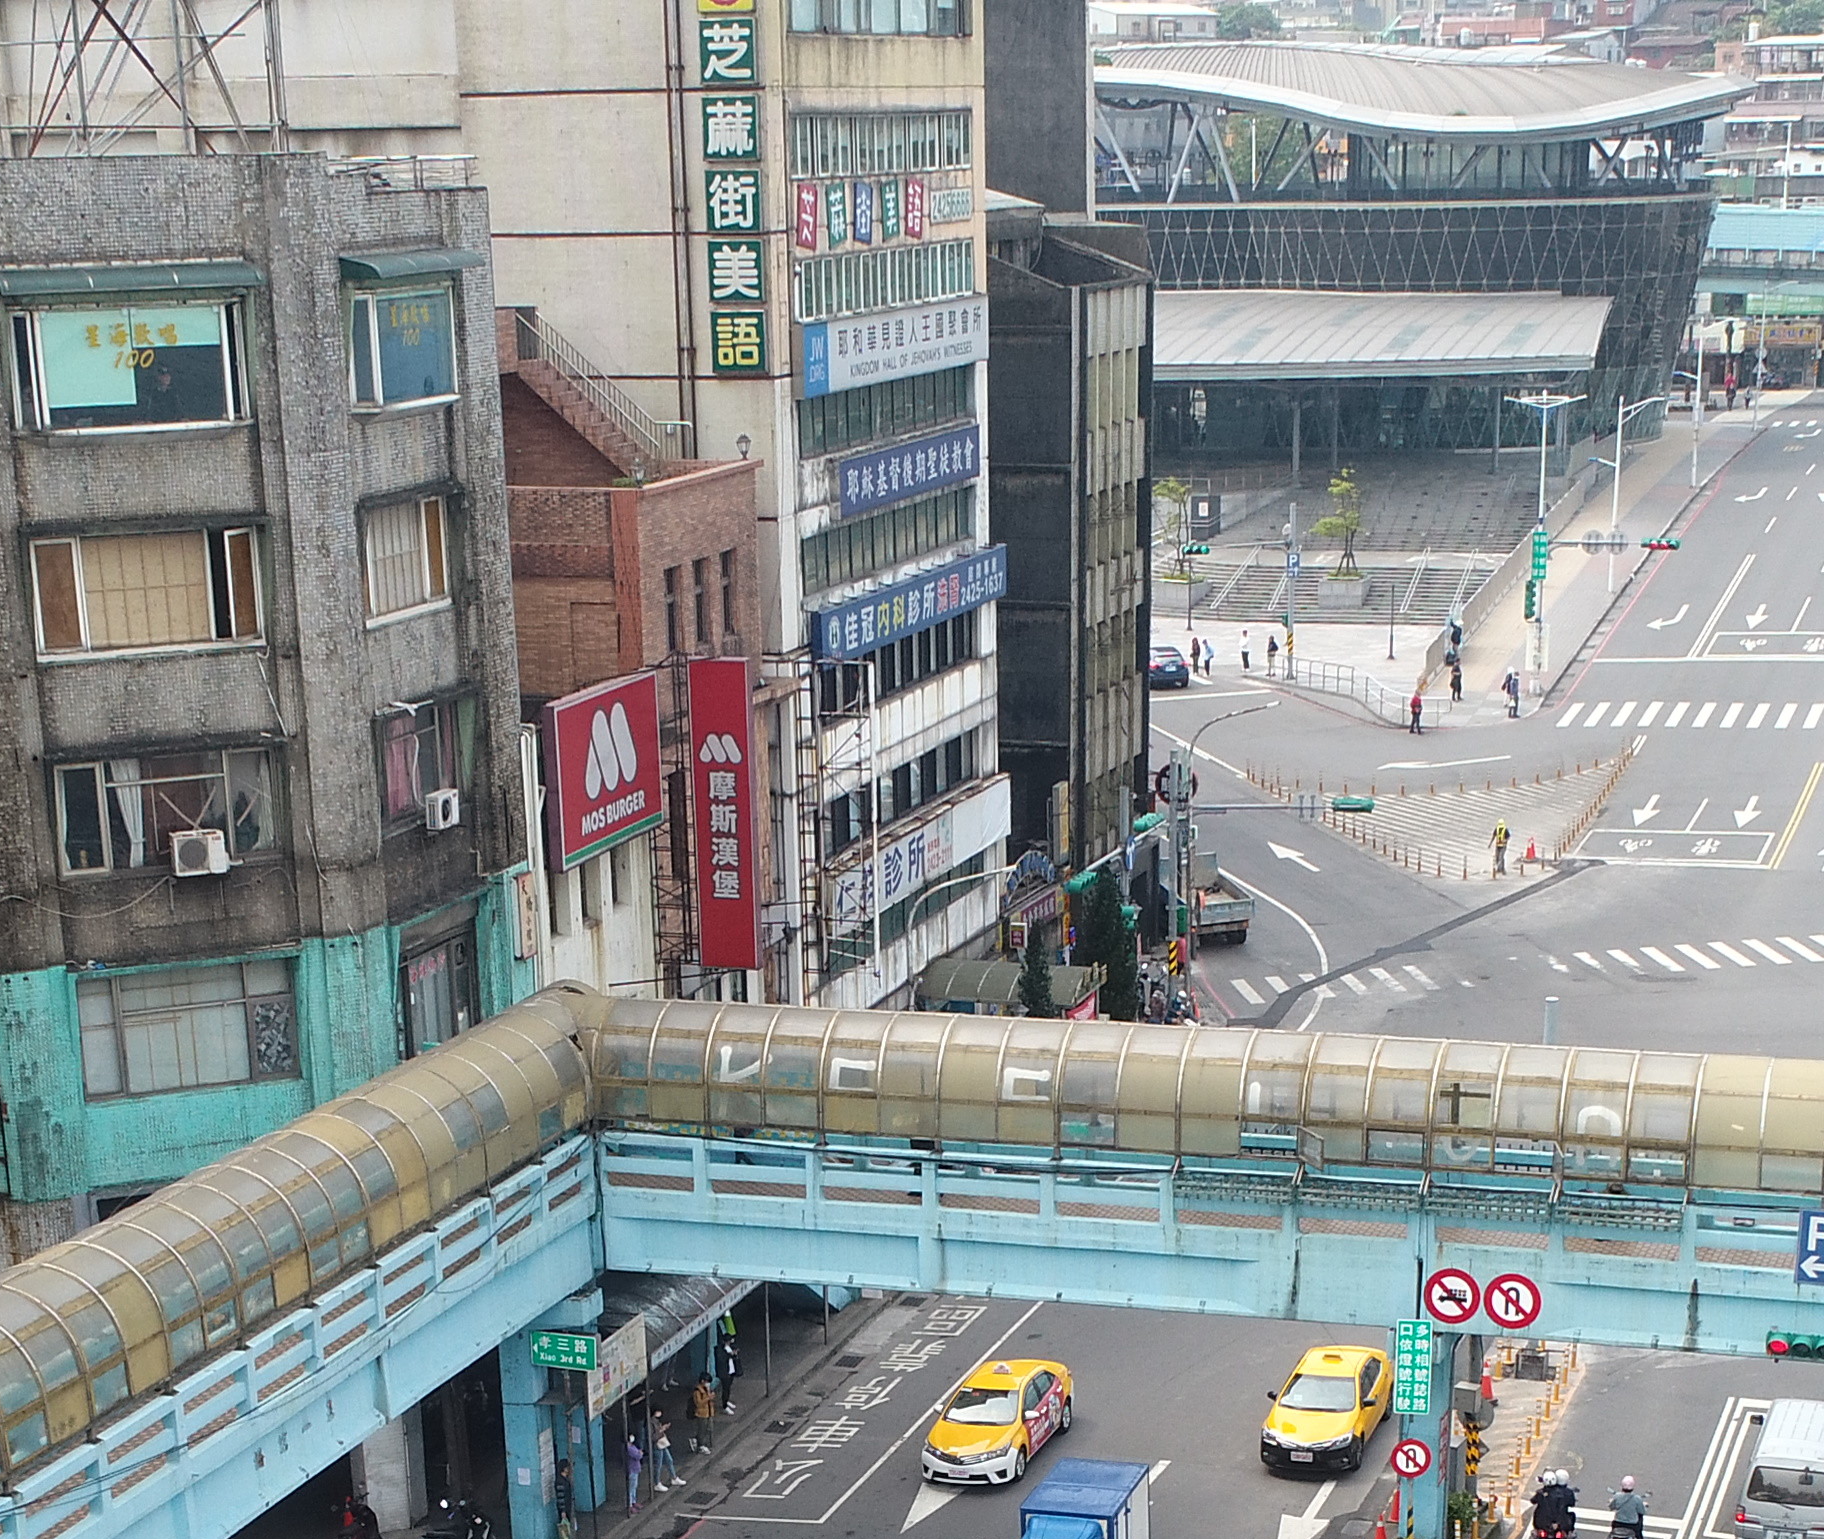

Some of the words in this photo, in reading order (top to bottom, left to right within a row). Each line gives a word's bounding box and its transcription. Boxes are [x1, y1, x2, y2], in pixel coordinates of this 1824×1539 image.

[702, 23, 760, 366] 芝麻街美語
[809, 337, 824, 360] JW
[850, 357, 880, 378] KINGDOM
[882, 354, 897, 371] HALL
[944, 341, 972, 358] WITNESSES
[847, 436, 974, 504] 耶穌基督後期聖徒教會
[582, 808, 606, 836] MOS
[606, 790, 646, 824] BURGER
[709, 771, 740, 899] 摩斯漢堡
[538, 1336, 587, 1353] 孝三路
[539, 1352, 556, 1362] Xiao
[560, 1353, 573, 1364] 3rd
[576, 1355, 587, 1365] Rd
[1397, 1324, 1414, 1410] 口依燈號行駛
[1413, 1324, 1429, 1411] 多時相號誌路
